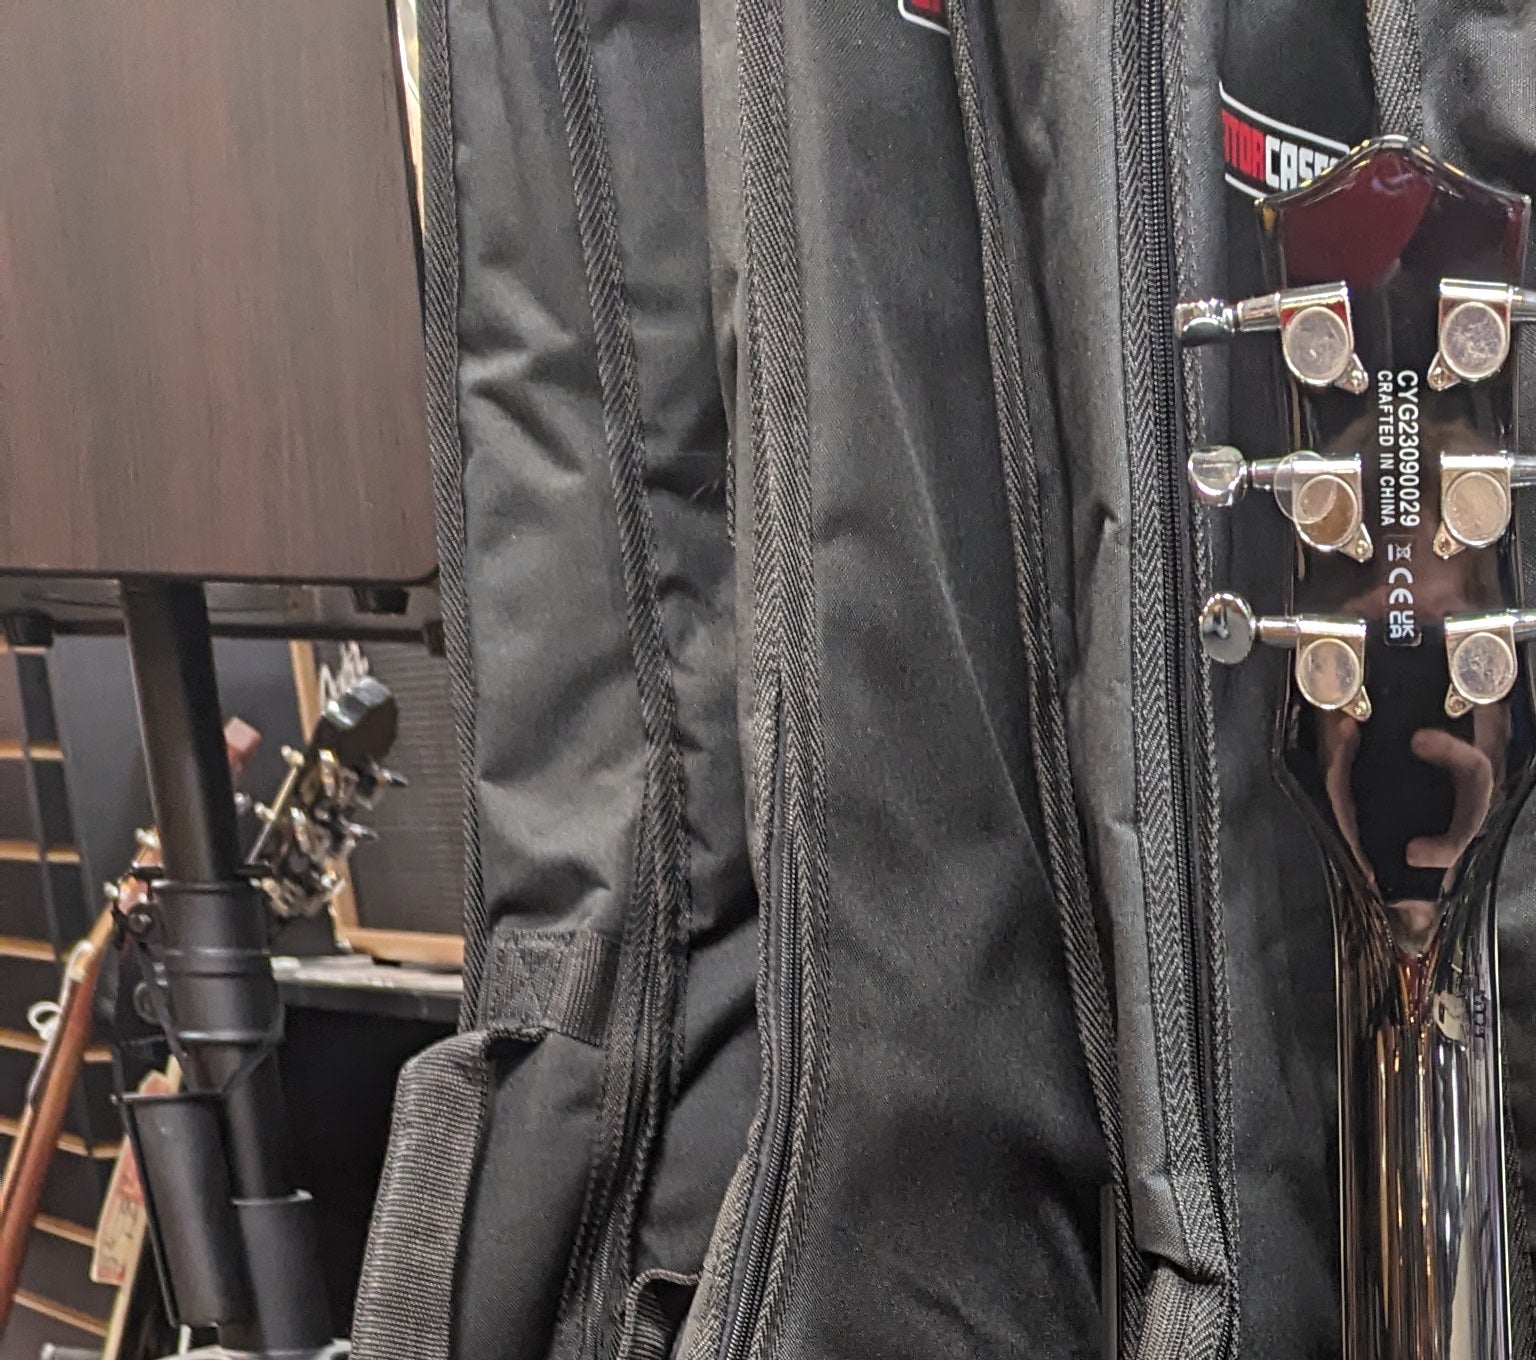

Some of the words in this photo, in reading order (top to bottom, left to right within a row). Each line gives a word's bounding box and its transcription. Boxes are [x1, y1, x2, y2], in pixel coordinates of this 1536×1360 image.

[1377, 370, 1395, 446] CRAFTED
[1379, 453, 1395, 470] IN
[1397, 370, 1421, 527] CYG23090029
[1379, 476, 1395, 526] CHINA
